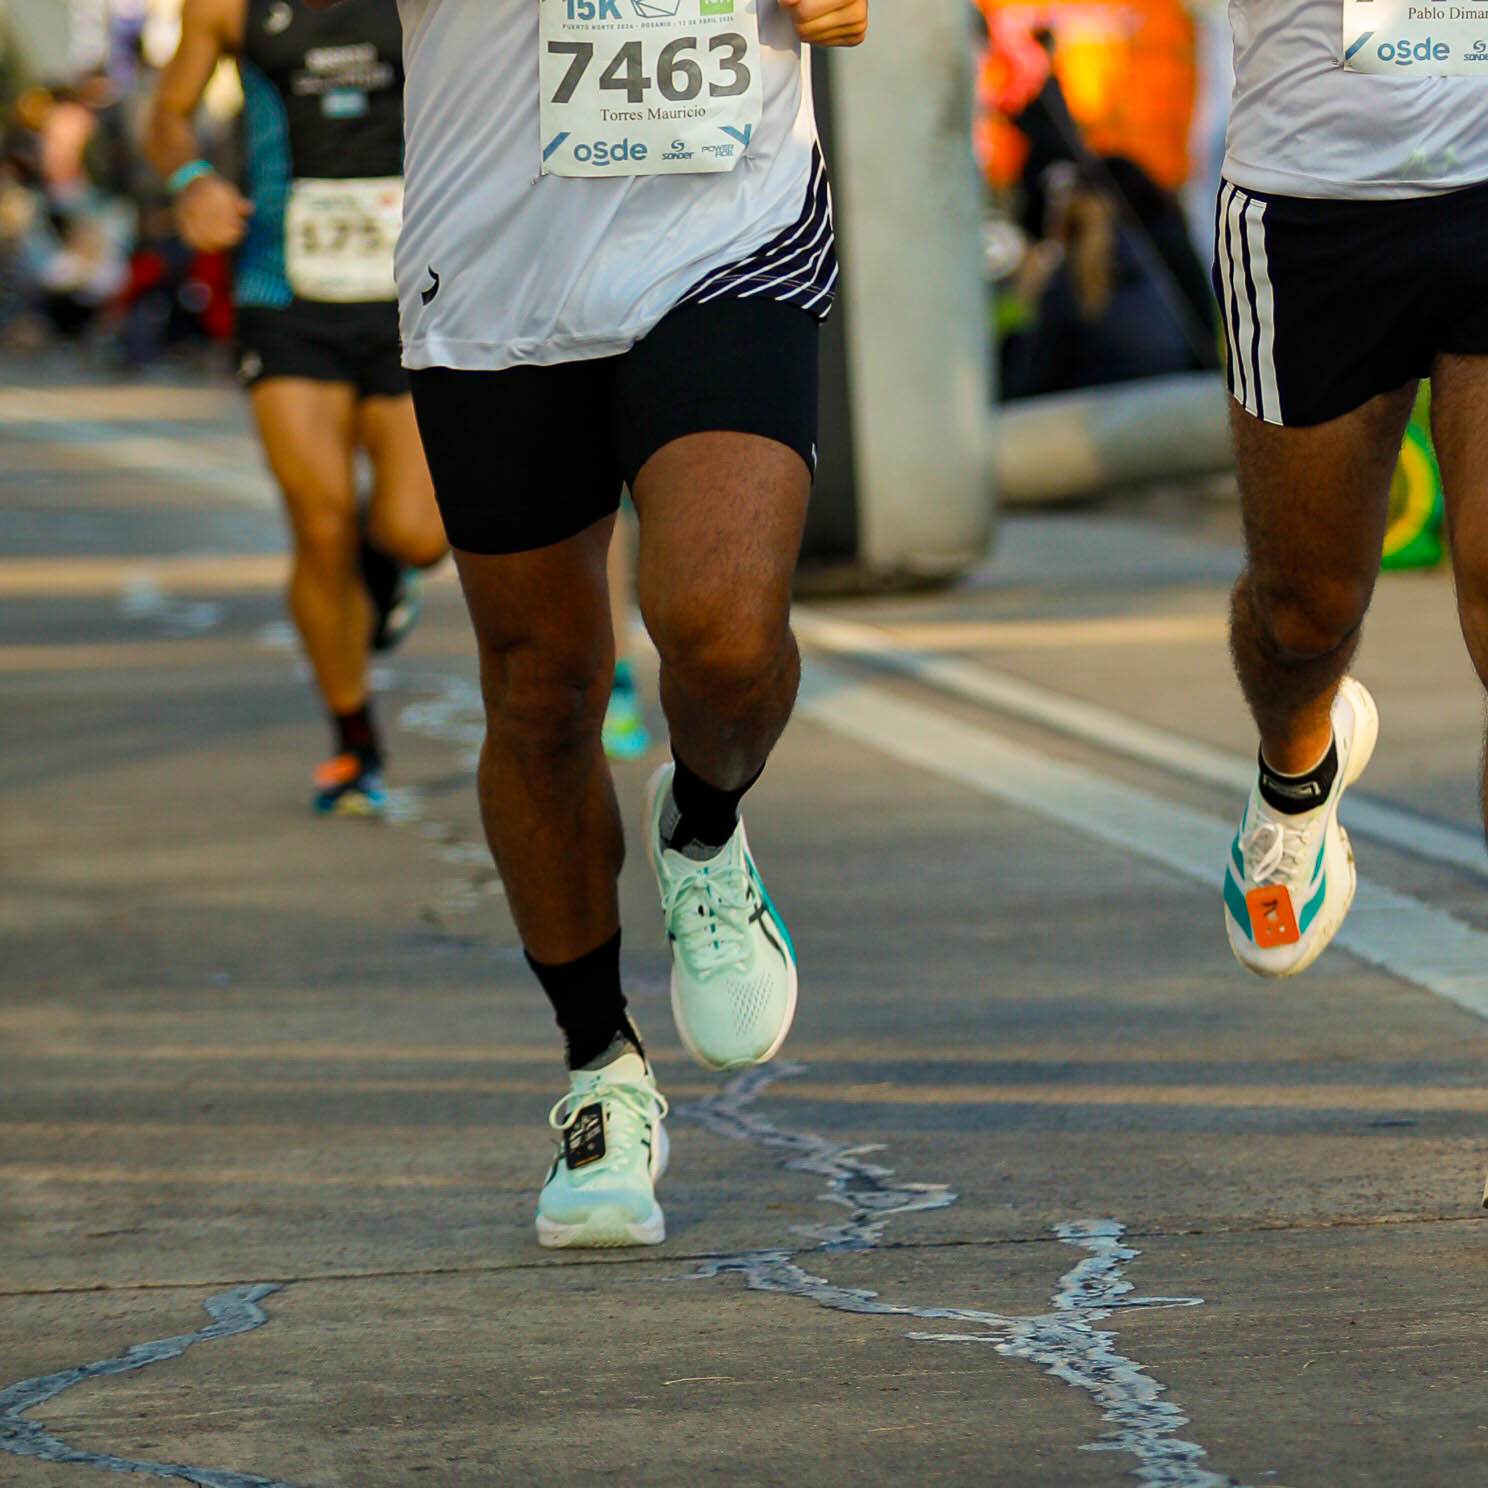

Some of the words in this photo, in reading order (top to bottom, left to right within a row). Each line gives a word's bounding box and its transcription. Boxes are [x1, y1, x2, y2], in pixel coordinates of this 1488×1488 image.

[1408, 7, 1445, 19] Pablo
[1377, 37, 1450, 62] osde
[547, 32, 751, 104] 7463
[600, 109, 643, 121] Torres
[647, 105, 706, 120] Mauricio
[574, 138, 648, 163] osde
